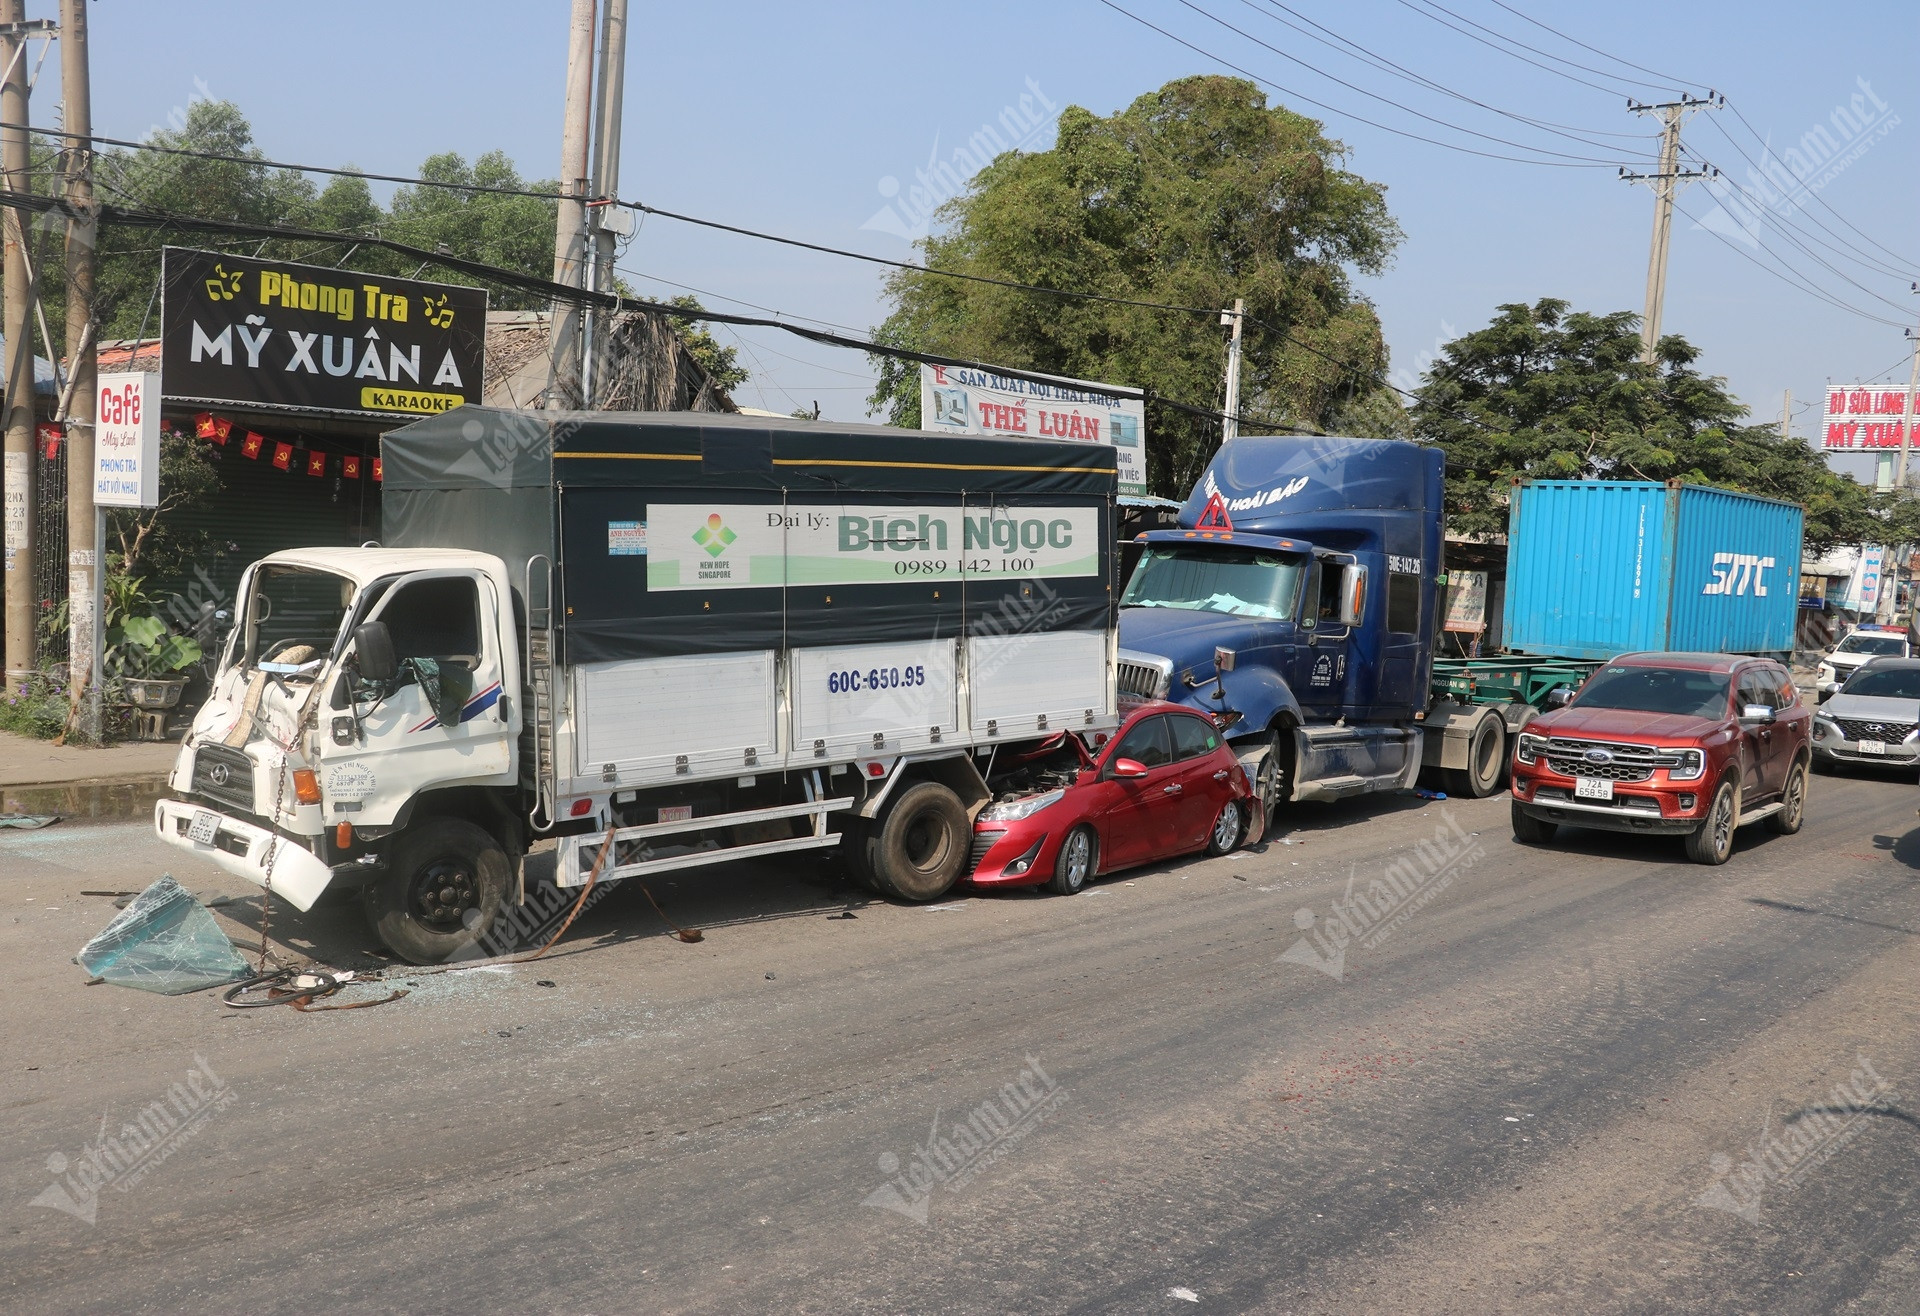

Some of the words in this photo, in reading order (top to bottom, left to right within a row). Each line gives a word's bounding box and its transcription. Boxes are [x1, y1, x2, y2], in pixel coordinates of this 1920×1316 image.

[190, 313, 273, 368] MỸ
[284, 326, 421, 385] XUÂN
[432, 348, 464, 388] A
[101, 383, 140, 425] Café
[373, 392, 453, 411] KARAOKE
[979, 397, 1027, 433] THẾ
[1038, 409, 1100, 442] LUÂN
[1118, 452, 1132, 463] ANG
[766, 512, 800, 530] Đại
[807, 512, 830, 531] lý:
[964, 515, 1072, 554] Ngọc
[698, 570, 731, 579] SINGAPORE
[699, 561, 714, 570] NEW
[714, 560, 730, 569] HOPE
[894, 559, 947, 576] 0989
[957, 558, 991, 573] 142
[1001, 557, 1034, 572] 100
[827, 665, 925, 694] 60C-650.95
[1579, 787, 1609, 798] 658.58
[1587, 780, 1602, 788] 72A
